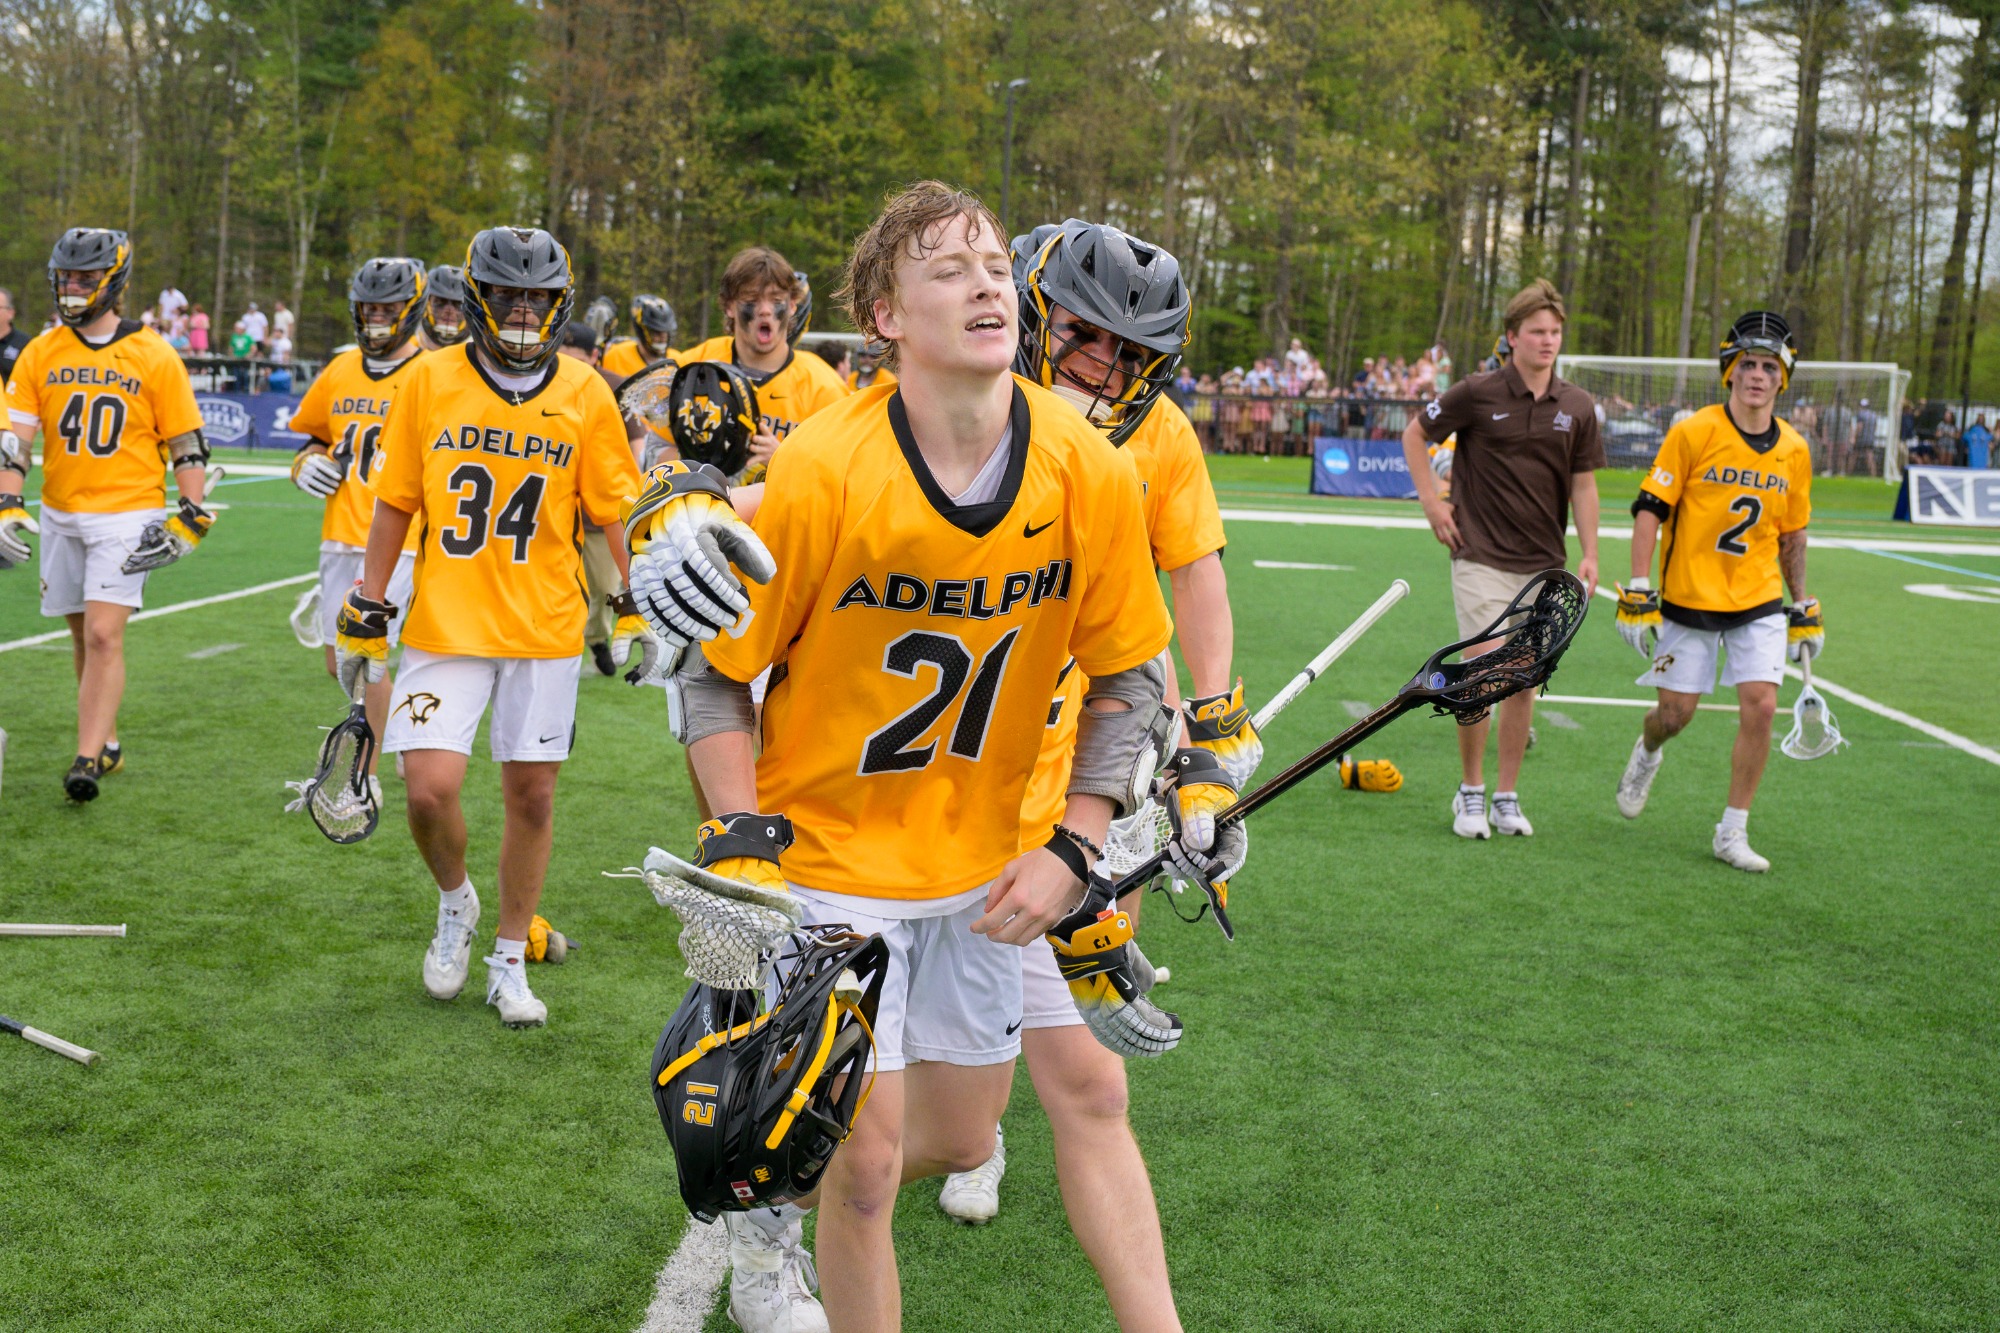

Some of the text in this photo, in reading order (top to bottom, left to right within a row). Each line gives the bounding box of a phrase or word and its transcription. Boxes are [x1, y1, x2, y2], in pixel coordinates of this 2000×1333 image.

[46, 367, 142, 396] ADELPHI
[58, 391, 128, 458] 40
[432, 424, 575, 469] ADELPHI
[1358, 455, 1409, 473] DIVIS
[1702, 465, 1788, 496] ADELPH
[440, 462, 548, 565] 34
[1714, 493, 1764, 558] 2
[831, 558, 1073, 620] ADELPHI
[856, 624, 1023, 777] 21
[682, 1081, 719, 1128] 21
